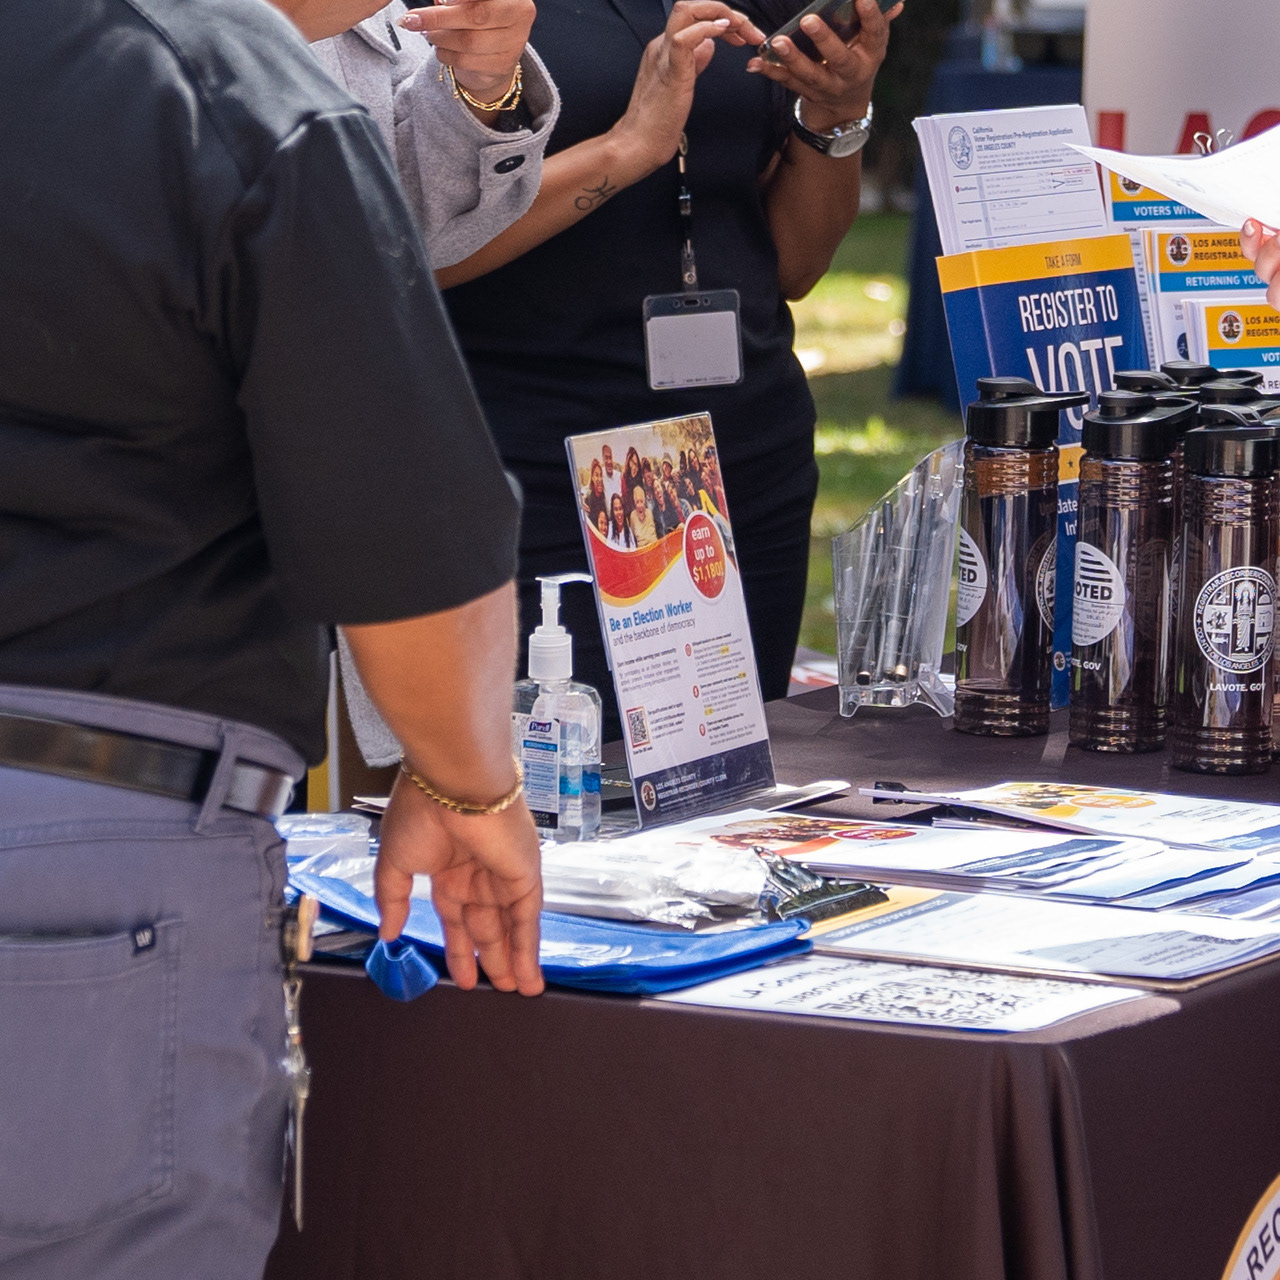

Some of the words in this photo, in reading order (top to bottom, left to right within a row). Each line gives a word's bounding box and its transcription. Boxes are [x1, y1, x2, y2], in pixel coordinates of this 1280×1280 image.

[1133, 205, 1172, 217] VOTERS
[1193, 239, 1209, 248] LOS
[1045, 255, 1061, 270] TAKE
[1065, 253, 1083, 267] FORM
[1185, 275, 1240, 287] RETURNING
[1243, 275, 1265, 285] YOU
[1018, 287, 1098, 333] REGISTER
[1095, 284, 1119, 322] TO
[1246, 316, 1262, 325] LOS
[691, 526, 710, 541] earn
[694, 548, 705, 563] up
[706, 545, 714, 558] to
[693, 560, 724, 583] $1,180!
[1075, 581, 1113, 601] OTED
[609, 618, 621, 632] Be
[622, 617, 632, 629] an
[633, 607, 665, 627] Election
[665, 600, 693, 618] Worker
[613, 634, 624, 646] and
[624, 632, 633, 643] the
[633, 626, 660, 641] backbone
[667, 618, 696, 632] democracy
[1083, 660, 1101, 671] GOV
